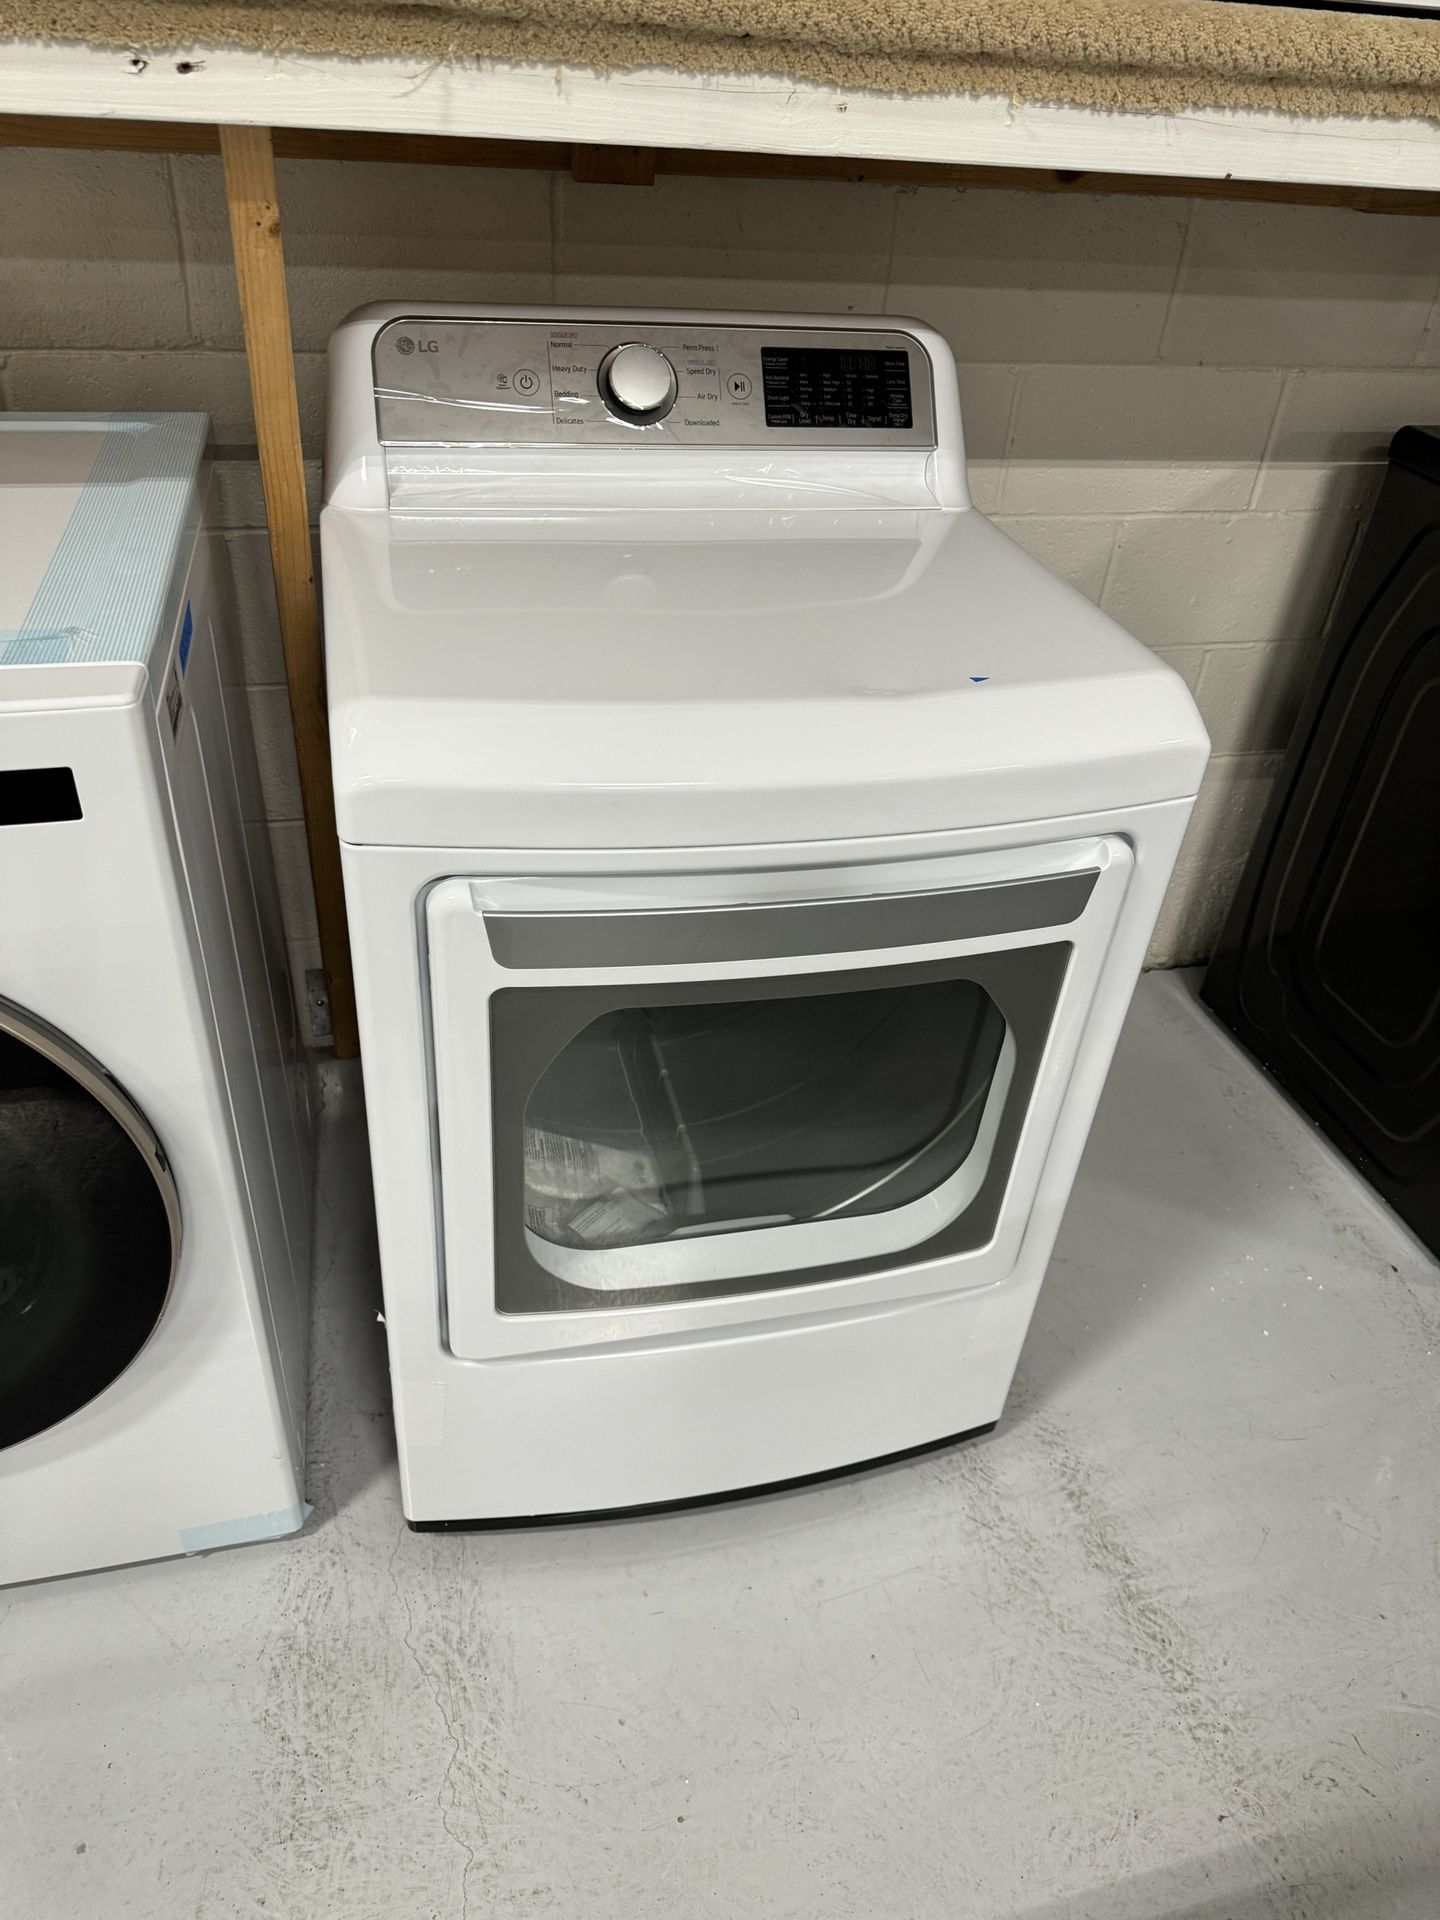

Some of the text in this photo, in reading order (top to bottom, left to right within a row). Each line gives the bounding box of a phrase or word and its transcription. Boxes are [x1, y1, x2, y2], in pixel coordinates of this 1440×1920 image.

[418, 340, 439, 353] LG
[552, 365, 587, 374] Heavy Duty
[687, 368, 716, 376] Speed Dry
[554, 390, 579, 398] Bedding
[707, 393, 718, 401] Dry
